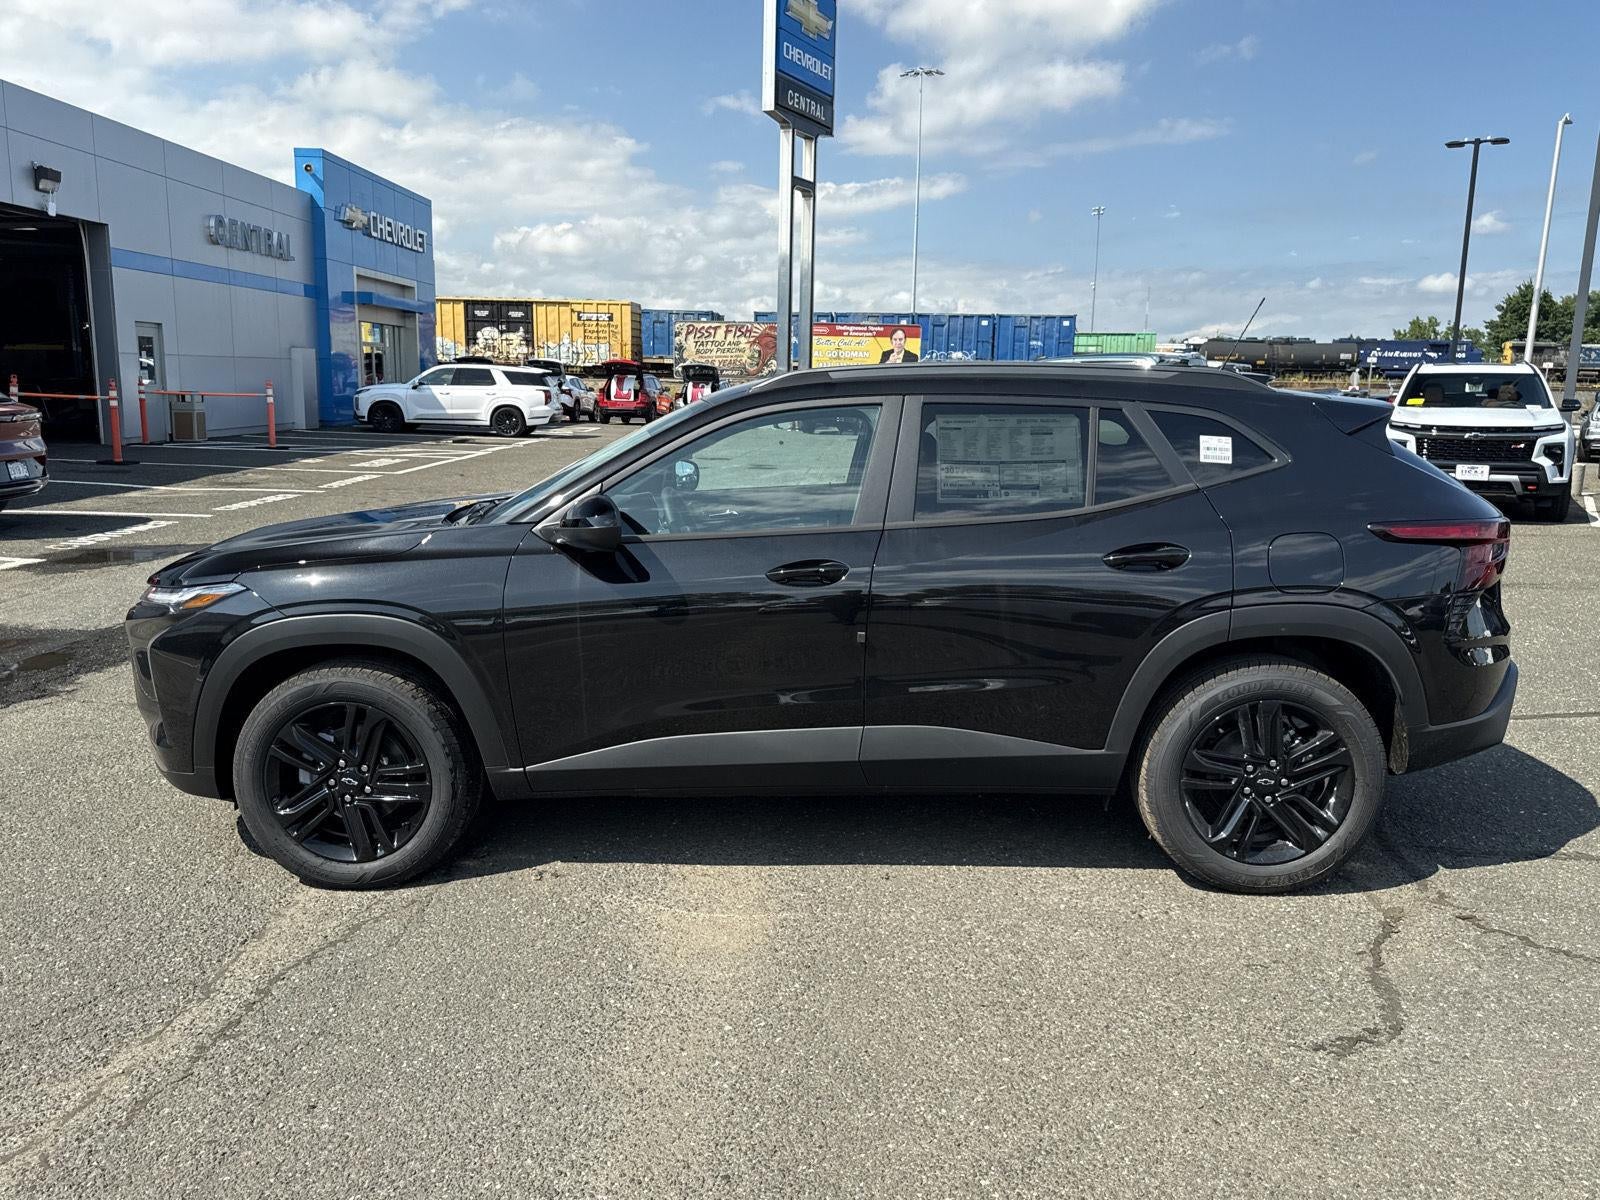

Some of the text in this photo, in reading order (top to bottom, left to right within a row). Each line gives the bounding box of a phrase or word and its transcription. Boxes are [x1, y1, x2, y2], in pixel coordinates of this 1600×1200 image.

[783, 41, 833, 80] CHEVROLET
[787, 89, 825, 120] CENTRAL
[209, 213, 296, 262] CENTRAL
[369, 210, 428, 254] CHEVROLET
[684, 323, 753, 342] PISST FISH
[694, 340, 742, 349] TATTOO AND
[695, 346, 746, 356] BODY PIERCING
[826, 350, 869, 358] GOODMAN
